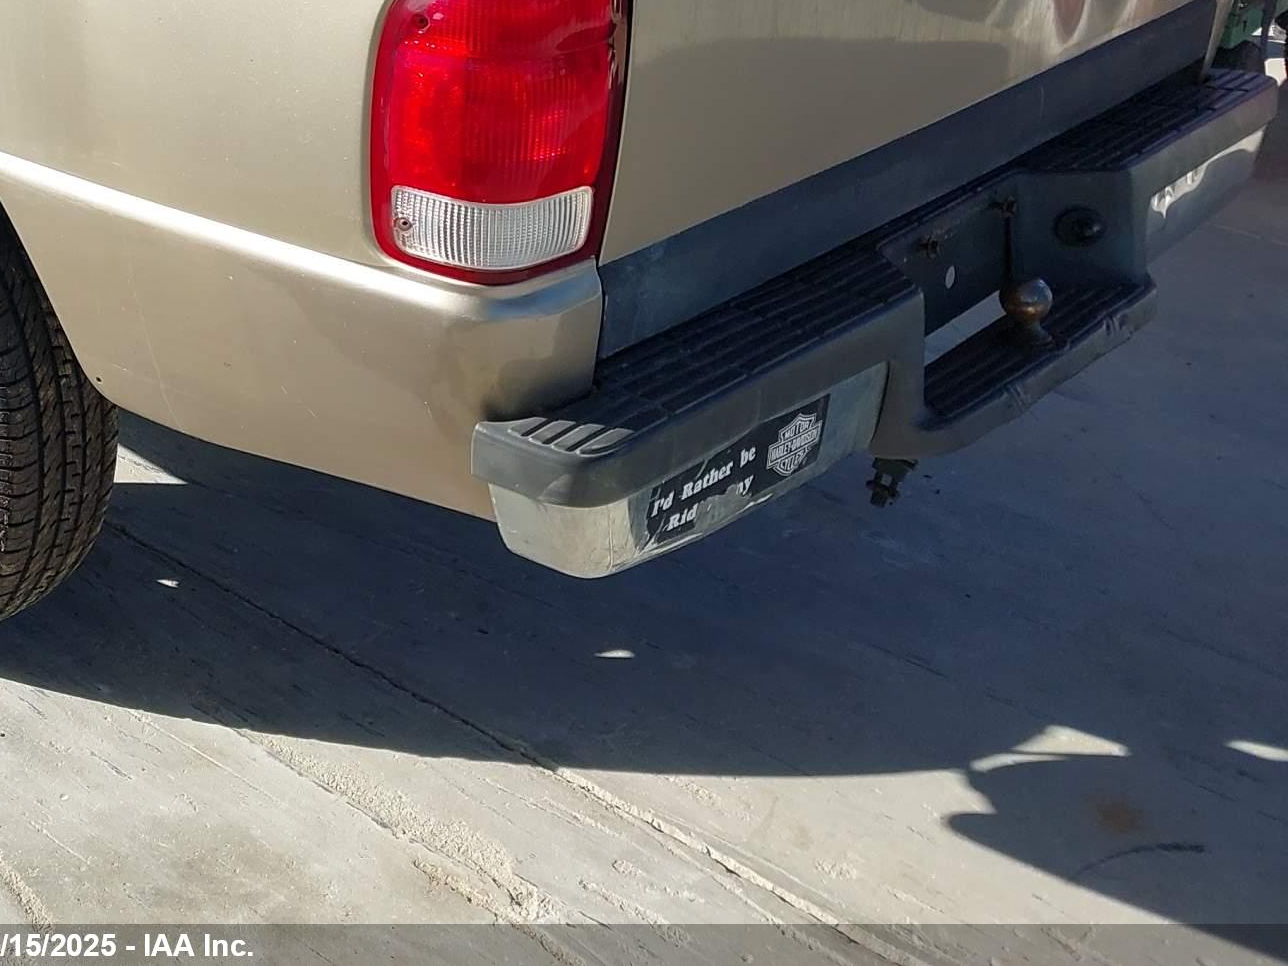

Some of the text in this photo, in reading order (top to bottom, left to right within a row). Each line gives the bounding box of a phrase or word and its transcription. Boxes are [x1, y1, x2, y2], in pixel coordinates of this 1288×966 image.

[770, 427, 818, 463] HARLEY-DAVIDSON
[783, 420, 811, 441] MOTOR
[650, 445, 757, 518] I'd Rather be
